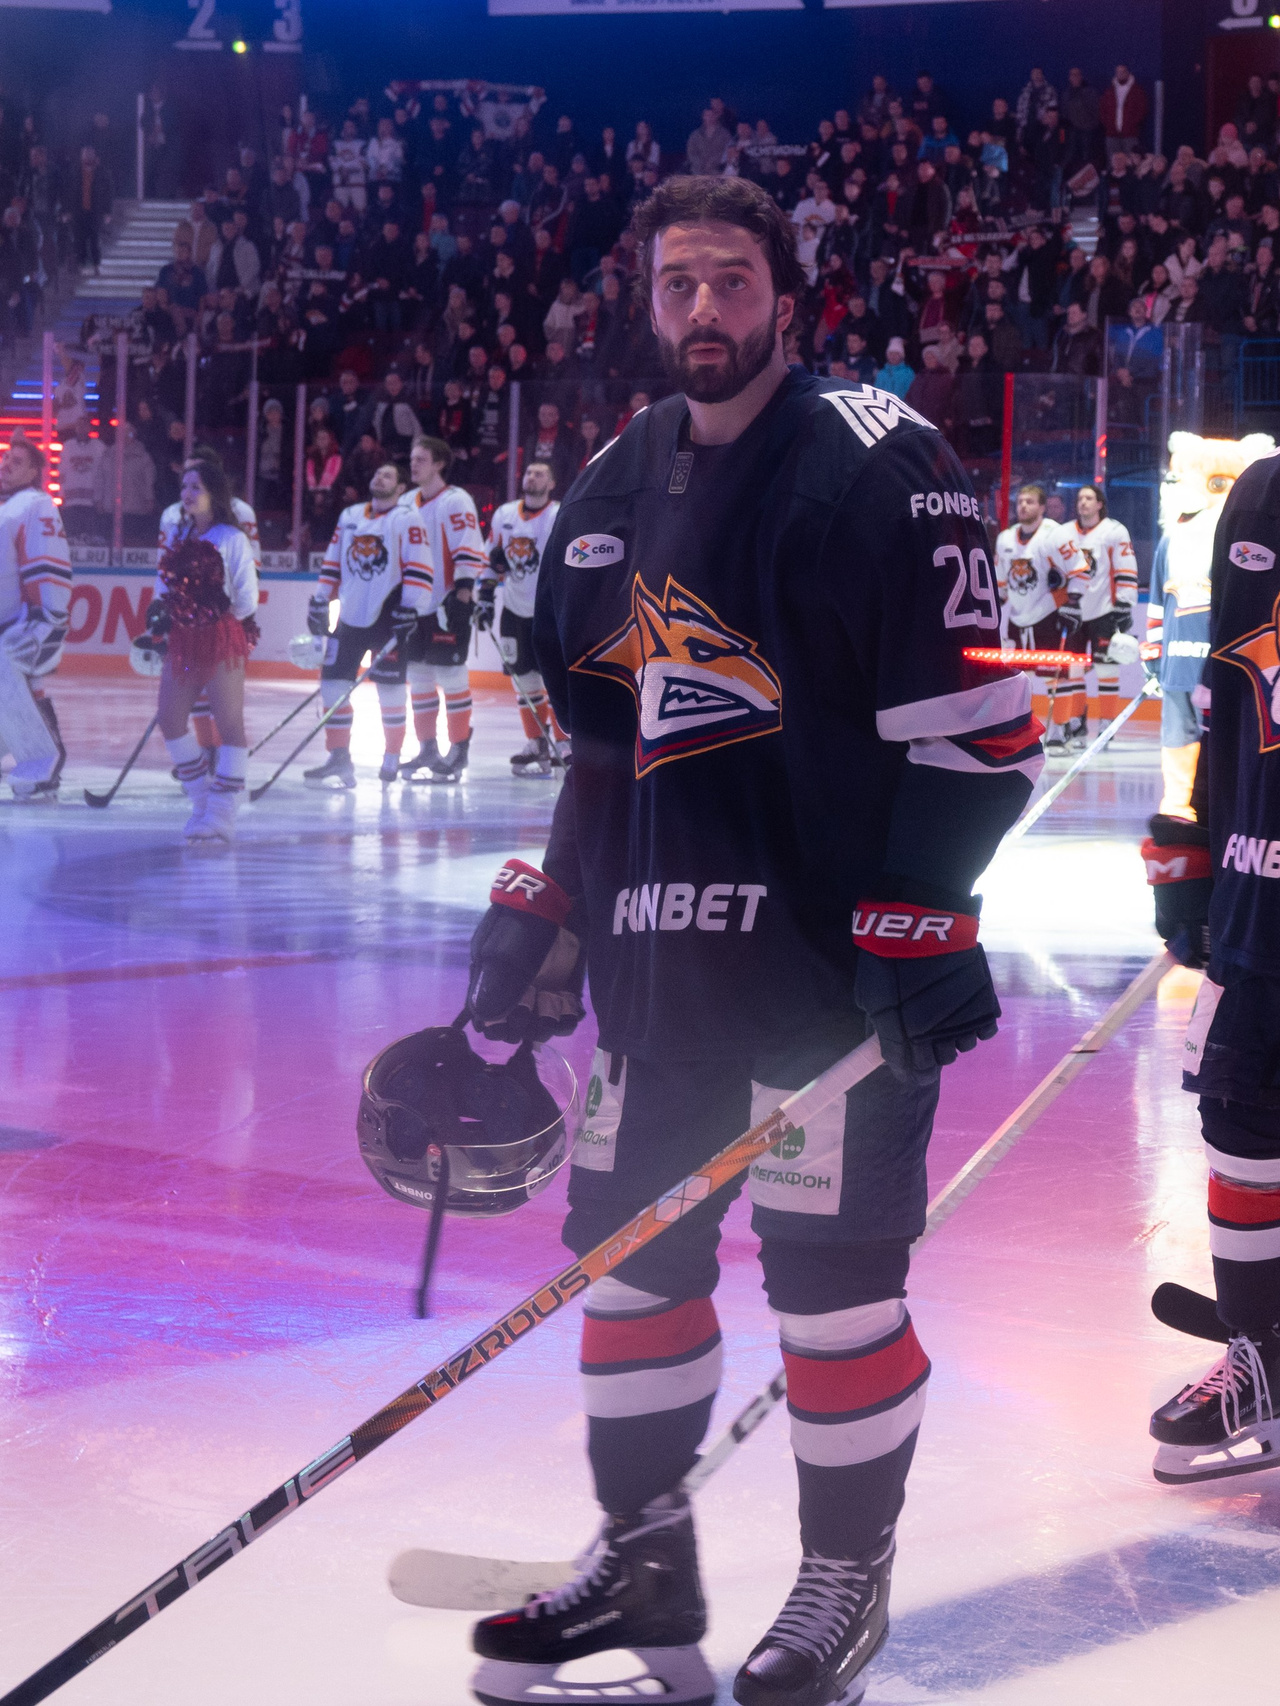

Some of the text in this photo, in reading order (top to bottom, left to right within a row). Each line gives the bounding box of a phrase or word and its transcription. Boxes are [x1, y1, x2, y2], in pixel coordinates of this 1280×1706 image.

[451, 513, 476, 531] 59
[910, 491, 983, 524] FONBE
[592, 544, 615, 555] сбп
[933, 545, 999, 629] 29
[393, 1181, 435, 1201] ONBET
[417, 1264, 592, 1405] HZRDUS
[113, 1435, 357, 1619] TRUE
